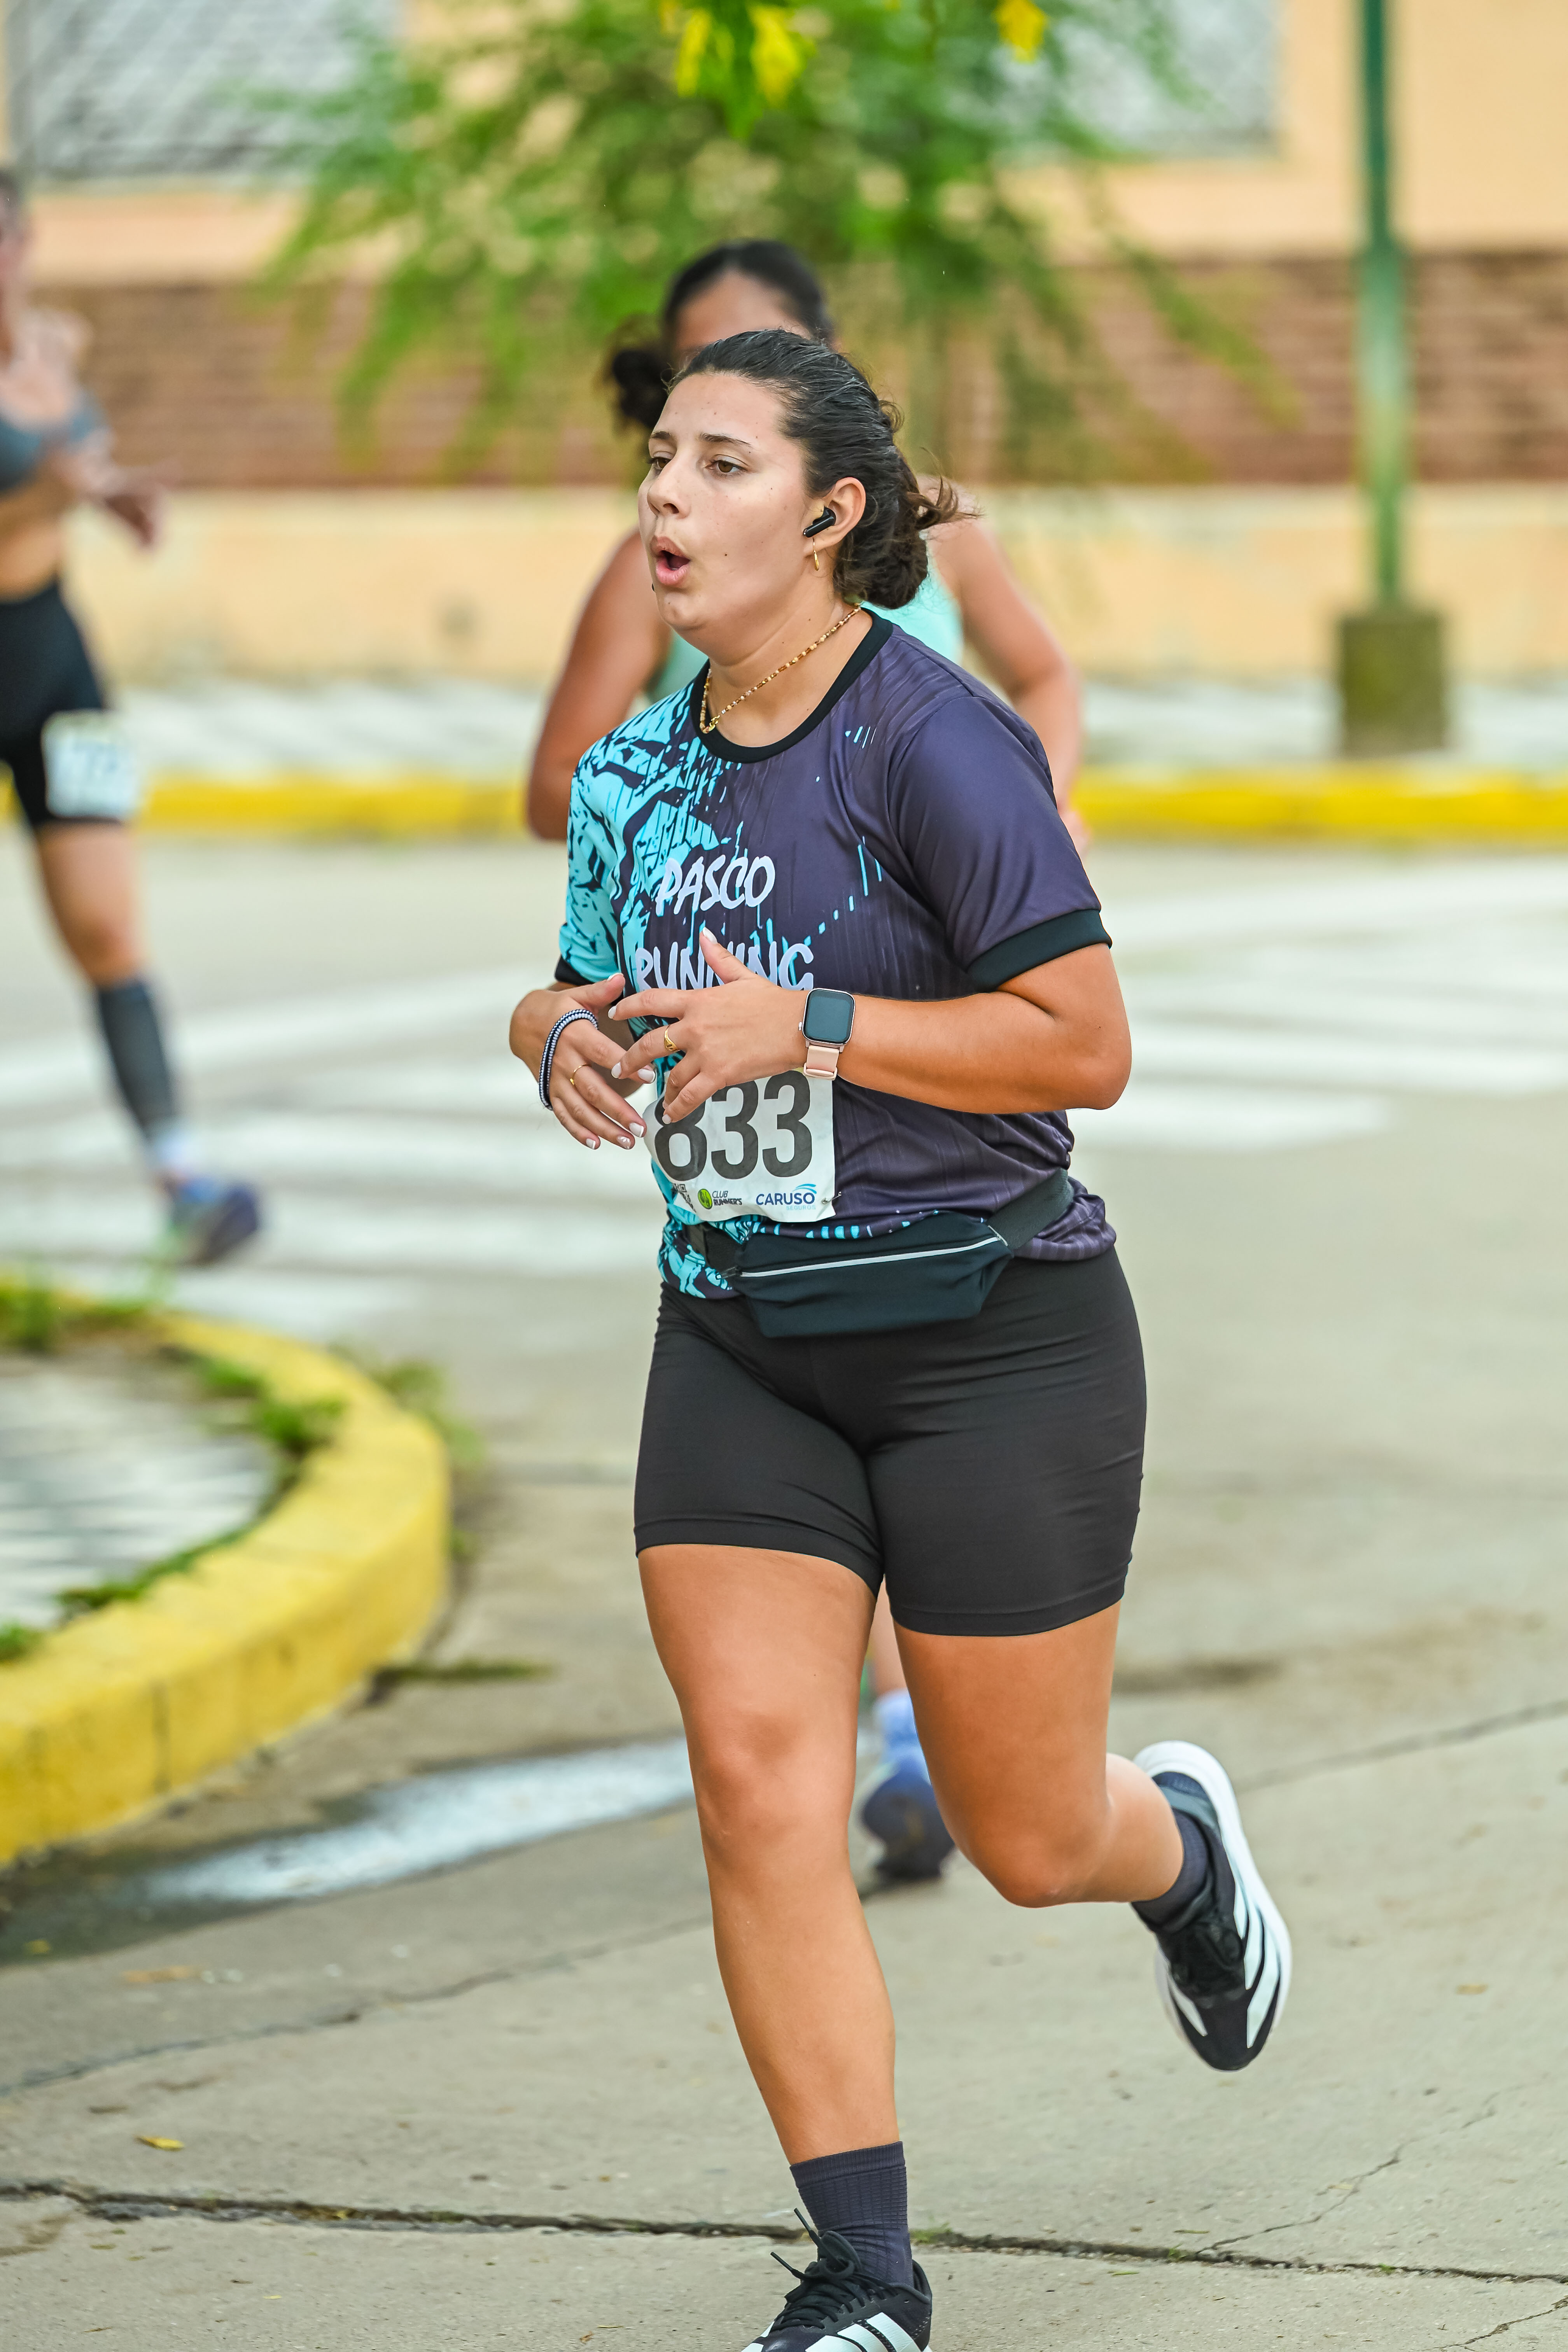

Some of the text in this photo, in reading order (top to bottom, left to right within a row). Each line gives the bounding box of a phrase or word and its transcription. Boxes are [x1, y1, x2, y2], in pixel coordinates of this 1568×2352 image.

[655, 854, 775, 917] PASCO
[654, 1070, 813, 1181] 833
[756, 1192, 815, 1206] CARUSO
